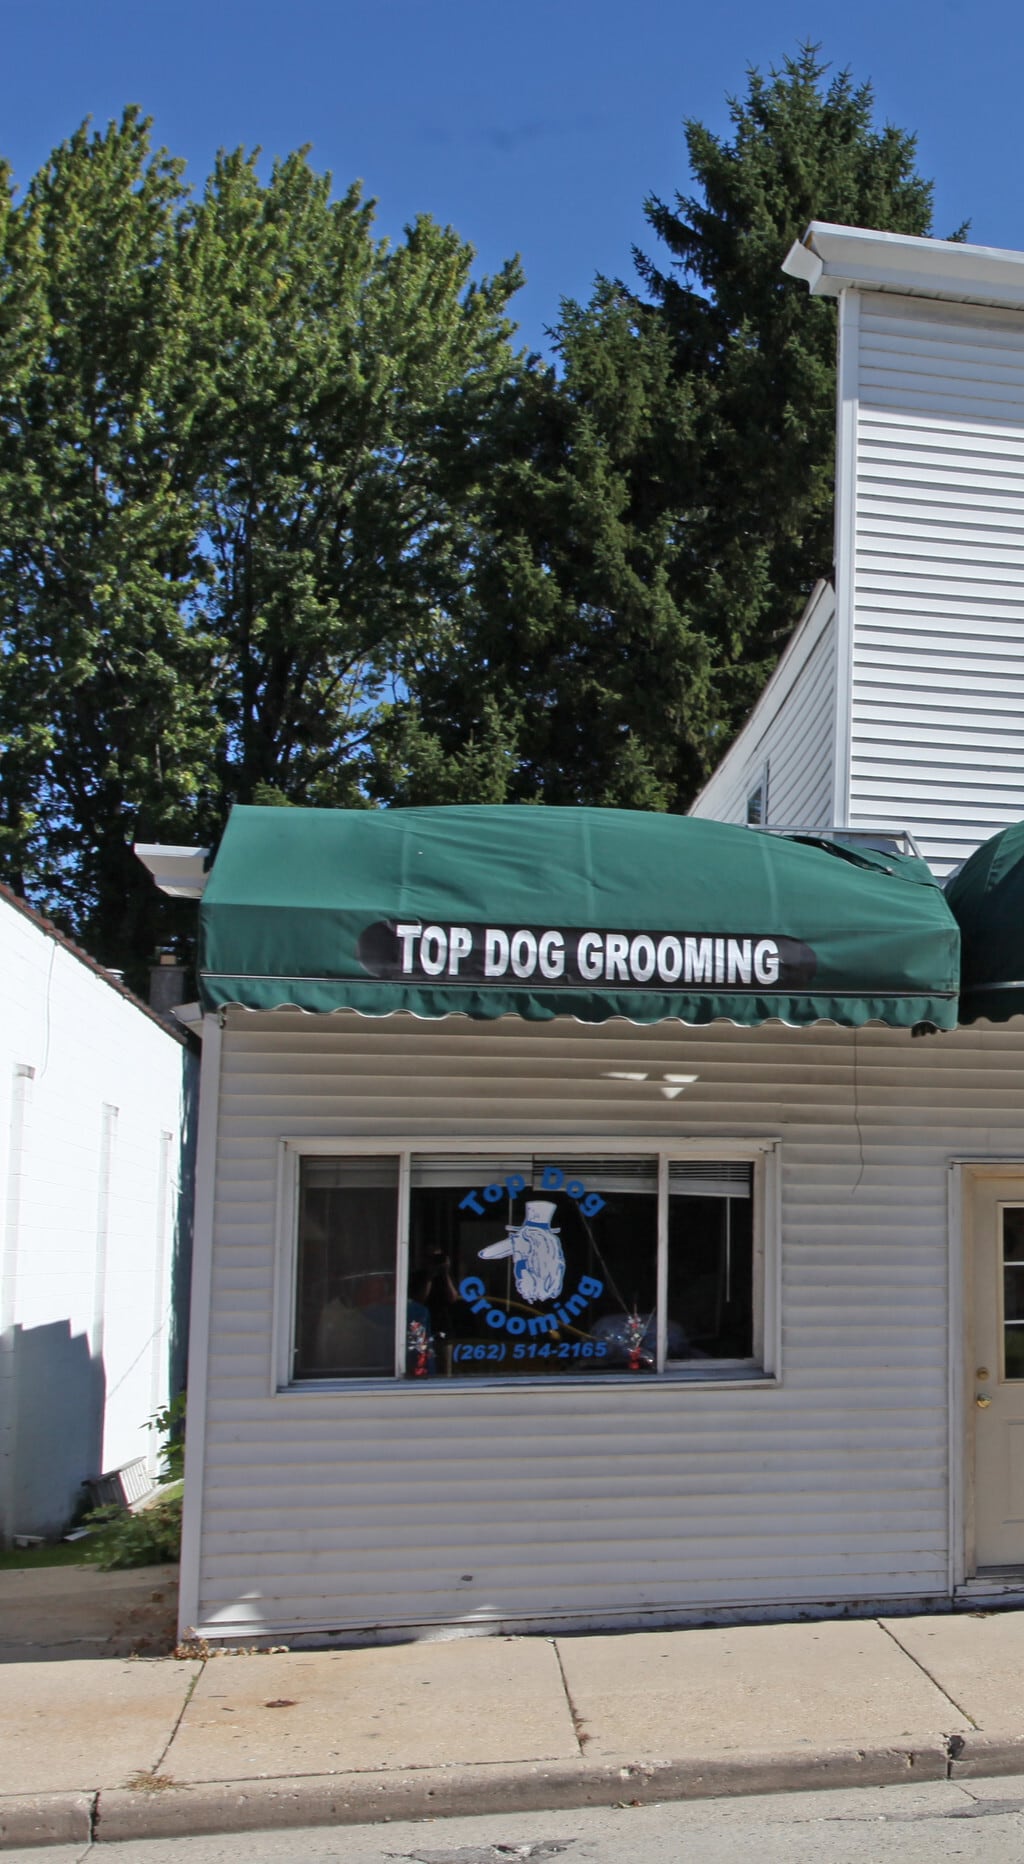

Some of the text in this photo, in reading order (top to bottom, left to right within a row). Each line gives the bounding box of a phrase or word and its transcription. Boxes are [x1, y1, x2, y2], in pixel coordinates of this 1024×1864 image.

[396, 924, 781, 985] TOP DOG GROOMING
[458, 1166, 608, 1218] Top Dog
[458, 1274, 605, 1337] Grooming
[452, 1341, 609, 1363] (262) 514-2165
